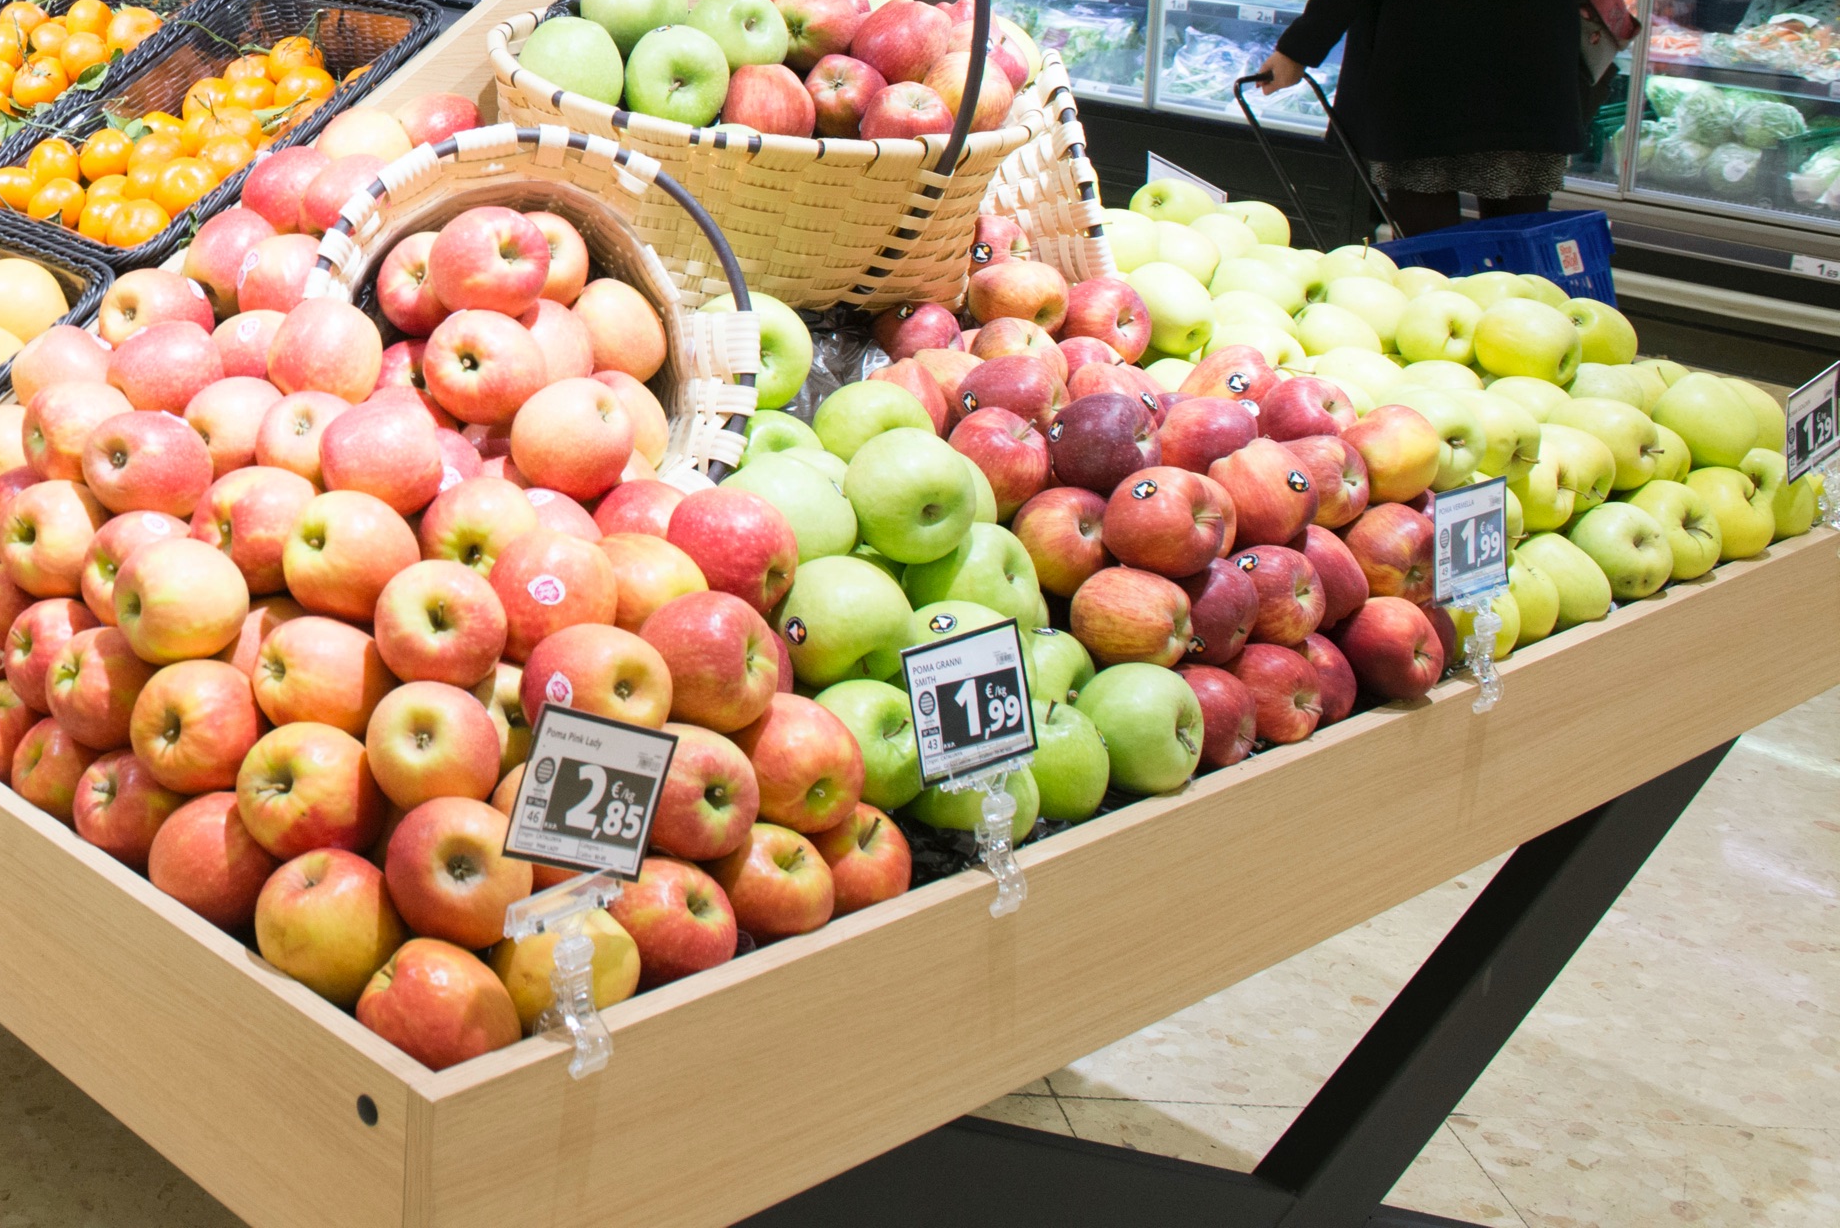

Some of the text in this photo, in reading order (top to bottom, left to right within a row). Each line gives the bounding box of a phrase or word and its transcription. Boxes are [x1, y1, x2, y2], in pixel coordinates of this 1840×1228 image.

[1803, 412, 1832, 450] 1,29
[1461, 518, 1501, 567] 1,99
[912, 663, 934, 675] POMA
[914, 676, 936, 688] SMITH
[954, 678, 1021, 740] 1,99
[546, 727, 602, 750] Poma Pink Lady
[927, 739, 938, 750] 43
[565, 764, 644, 839] 2,85
[527, 810, 540, 823] 46
